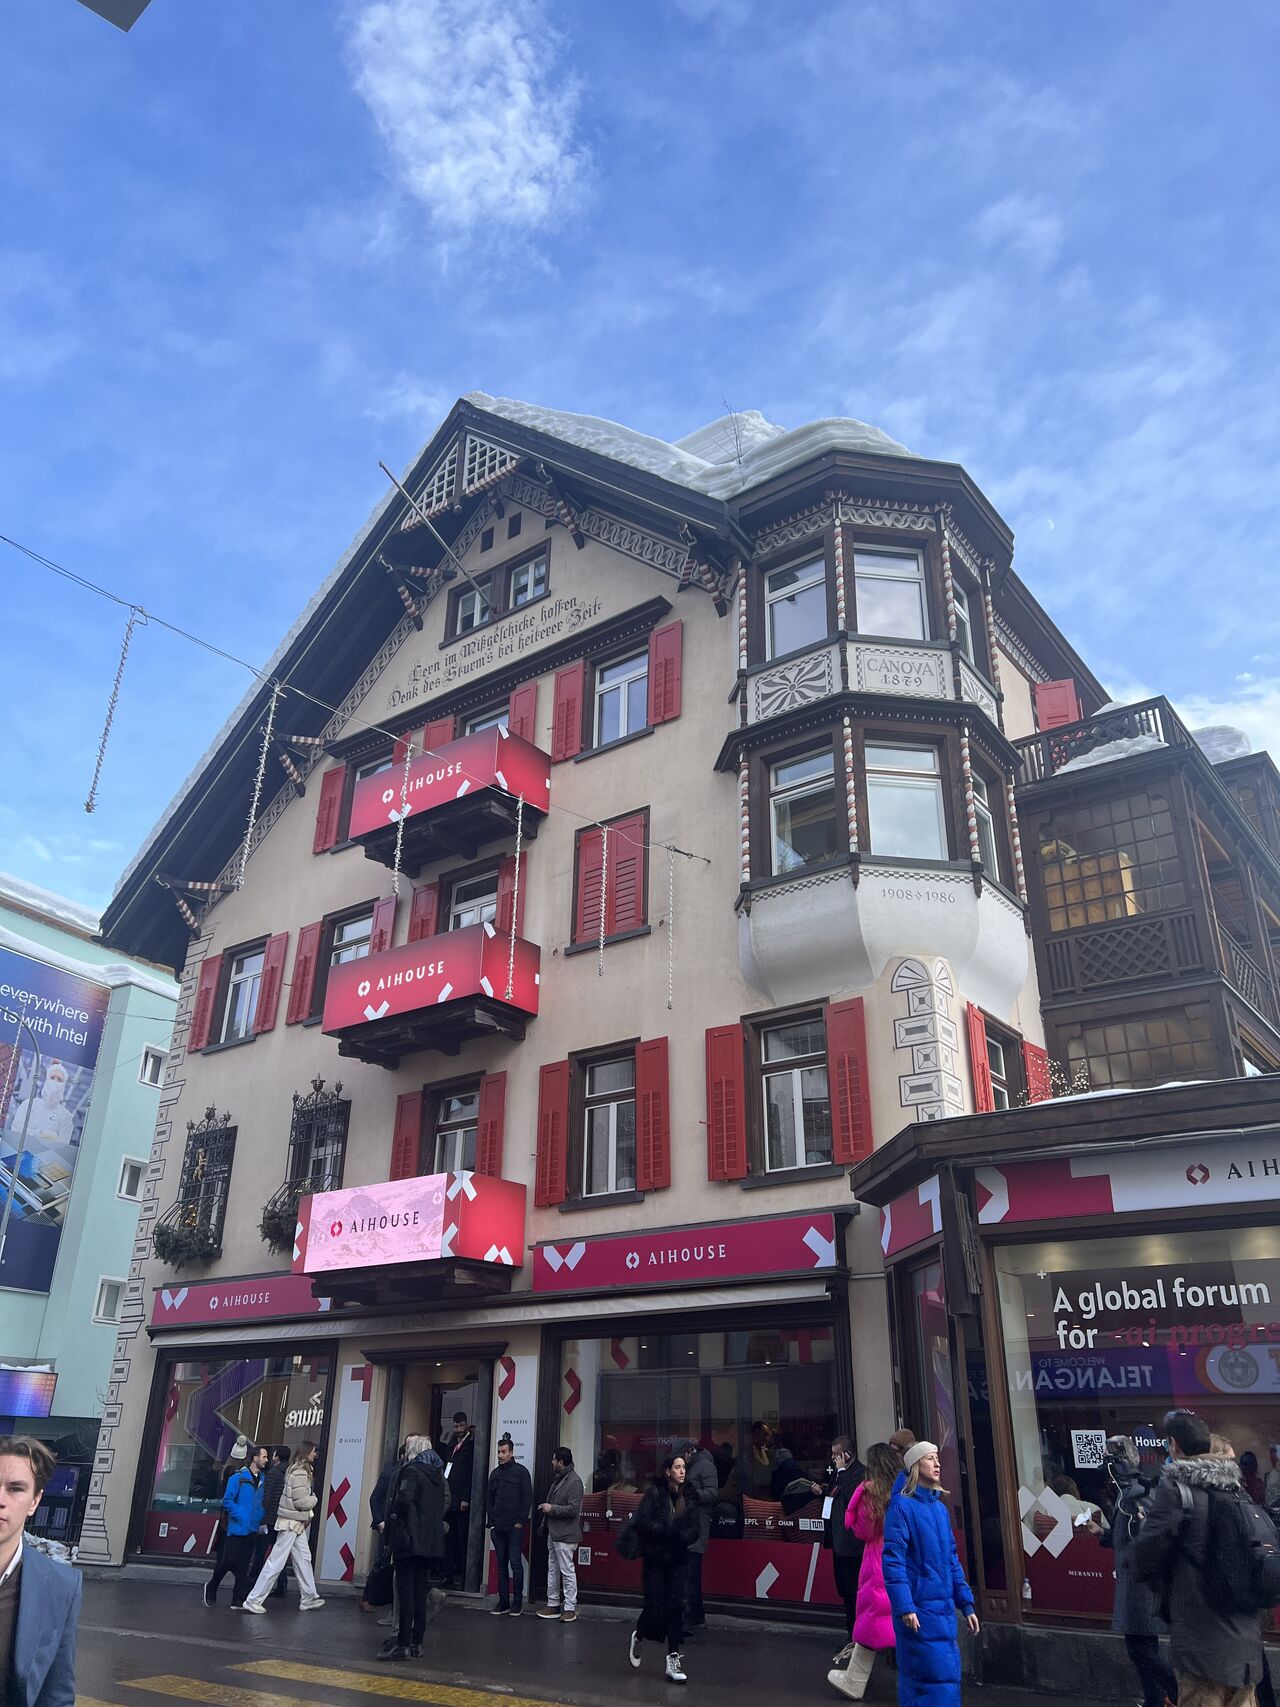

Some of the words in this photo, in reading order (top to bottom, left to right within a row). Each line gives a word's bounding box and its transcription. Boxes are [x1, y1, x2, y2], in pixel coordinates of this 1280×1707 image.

[408, 659, 440, 685] Lern
[445, 653, 457, 667] im
[540, 597, 577, 625] hoffen
[386, 684, 419, 710] Denk
[423, 677, 440, 693] des
[498, 638, 514, 658] bei
[866, 658, 935, 676] CANOVA
[376, 961, 444, 991] AIHOUSE
[0, 984, 89, 1024] everywhere
[21, 1016, 53, 1036] with
[55, 1023, 88, 1046] Intel
[1227, 1158, 1280, 1180] AIH
[350, 1211, 420, 1234] AIHOUSE
[648, 1244, 727, 1265] AIHOUSE
[222, 1292, 270, 1307] AIHOUSE
[1053, 1286, 1073, 1312] A
[1078, 1279, 1166, 1320] global
[1173, 1277, 1271, 1308] forum
[1056, 1320, 1098, 1349] for
